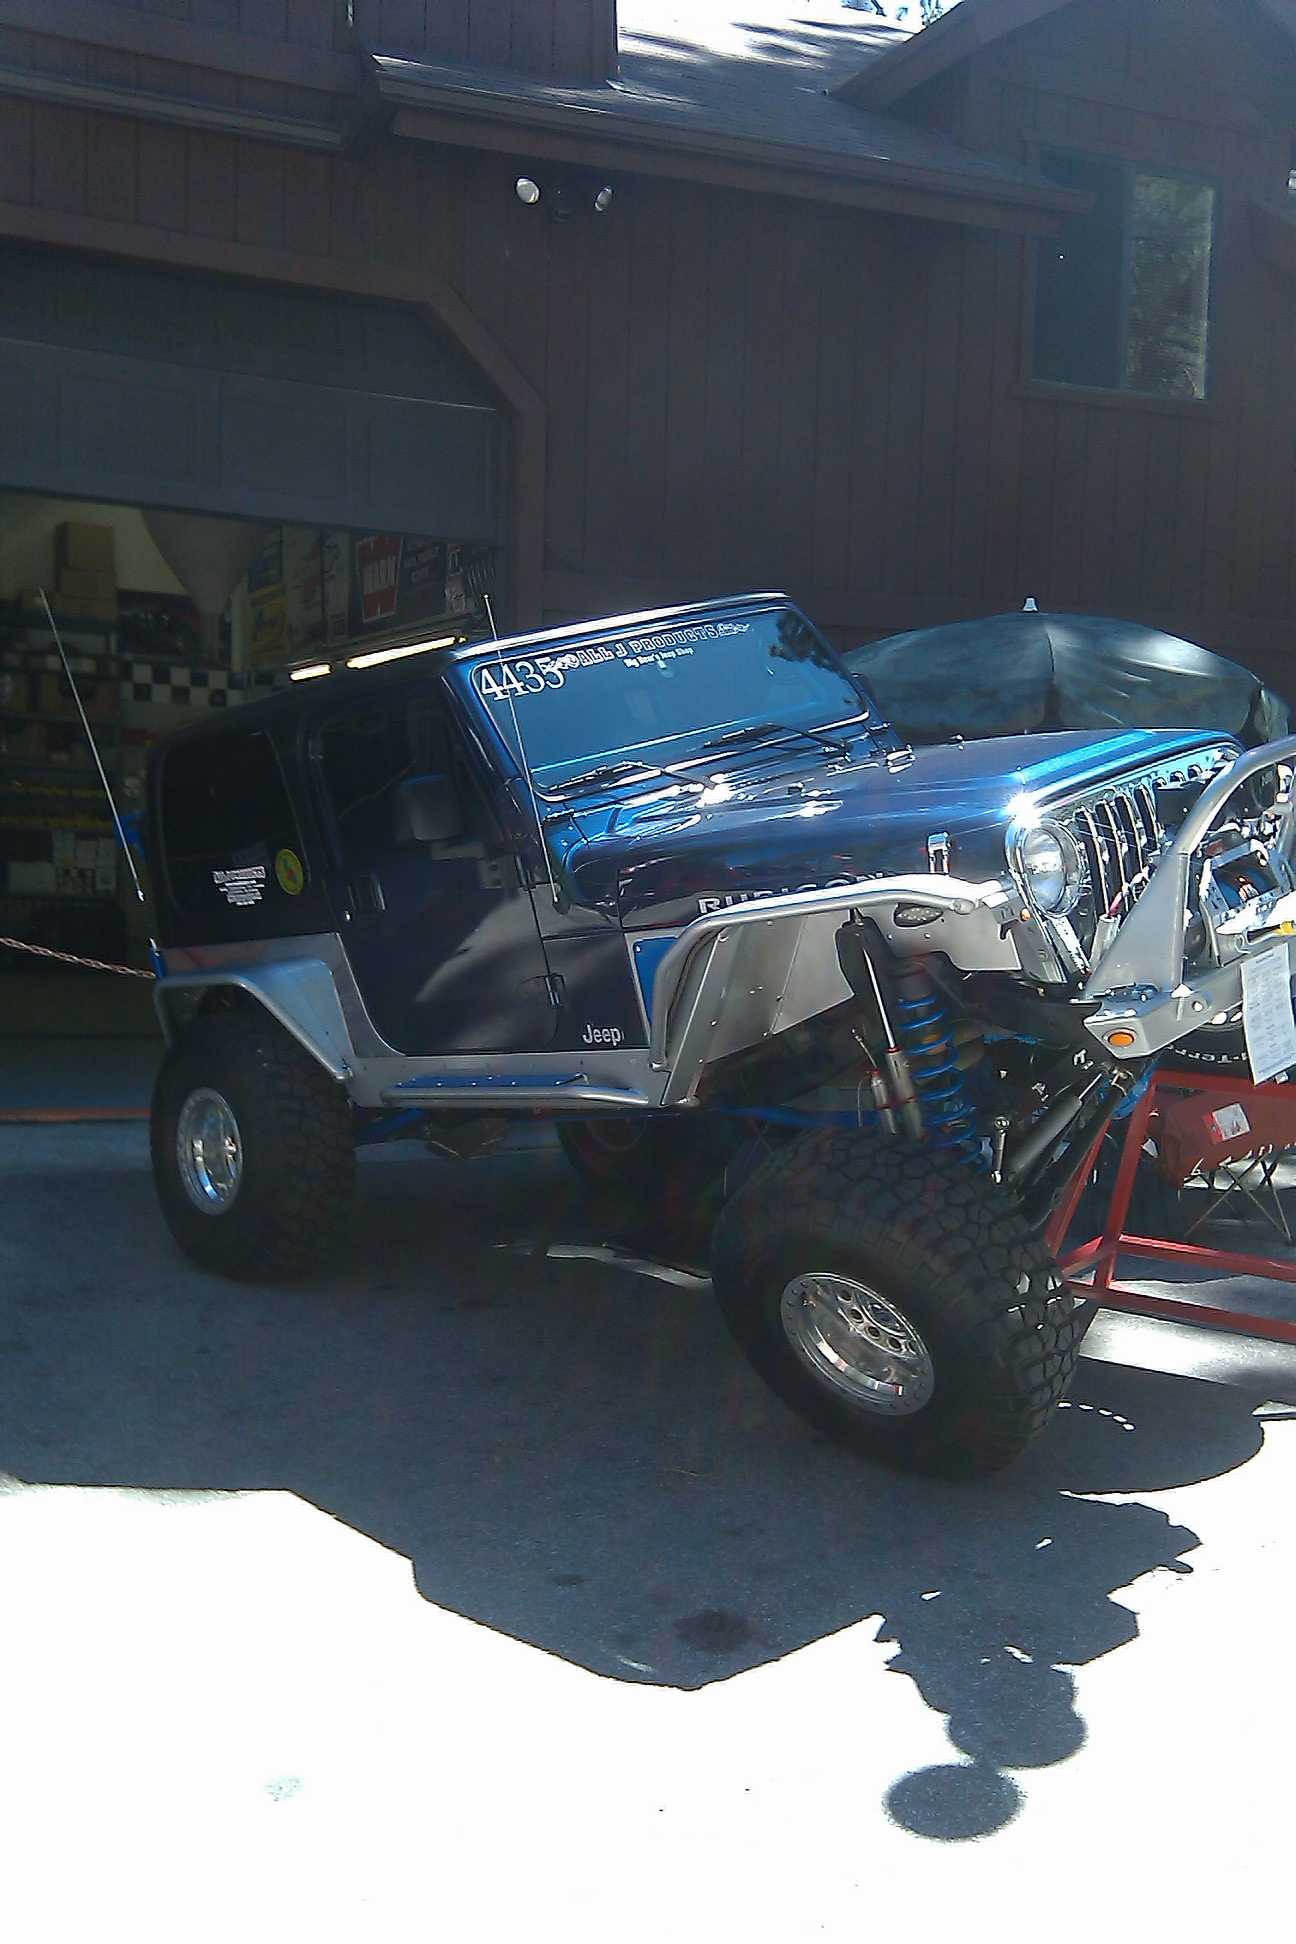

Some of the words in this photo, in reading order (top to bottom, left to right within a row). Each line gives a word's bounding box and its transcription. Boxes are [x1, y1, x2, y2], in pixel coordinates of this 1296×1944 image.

[576, 646, 615, 667] ALL
[614, 642, 628, 658] J
[628, 624, 719, 654] PRODUCTS
[481, 656, 565, 700] 4435
[582, 1024, 621, 1046] Jeep
